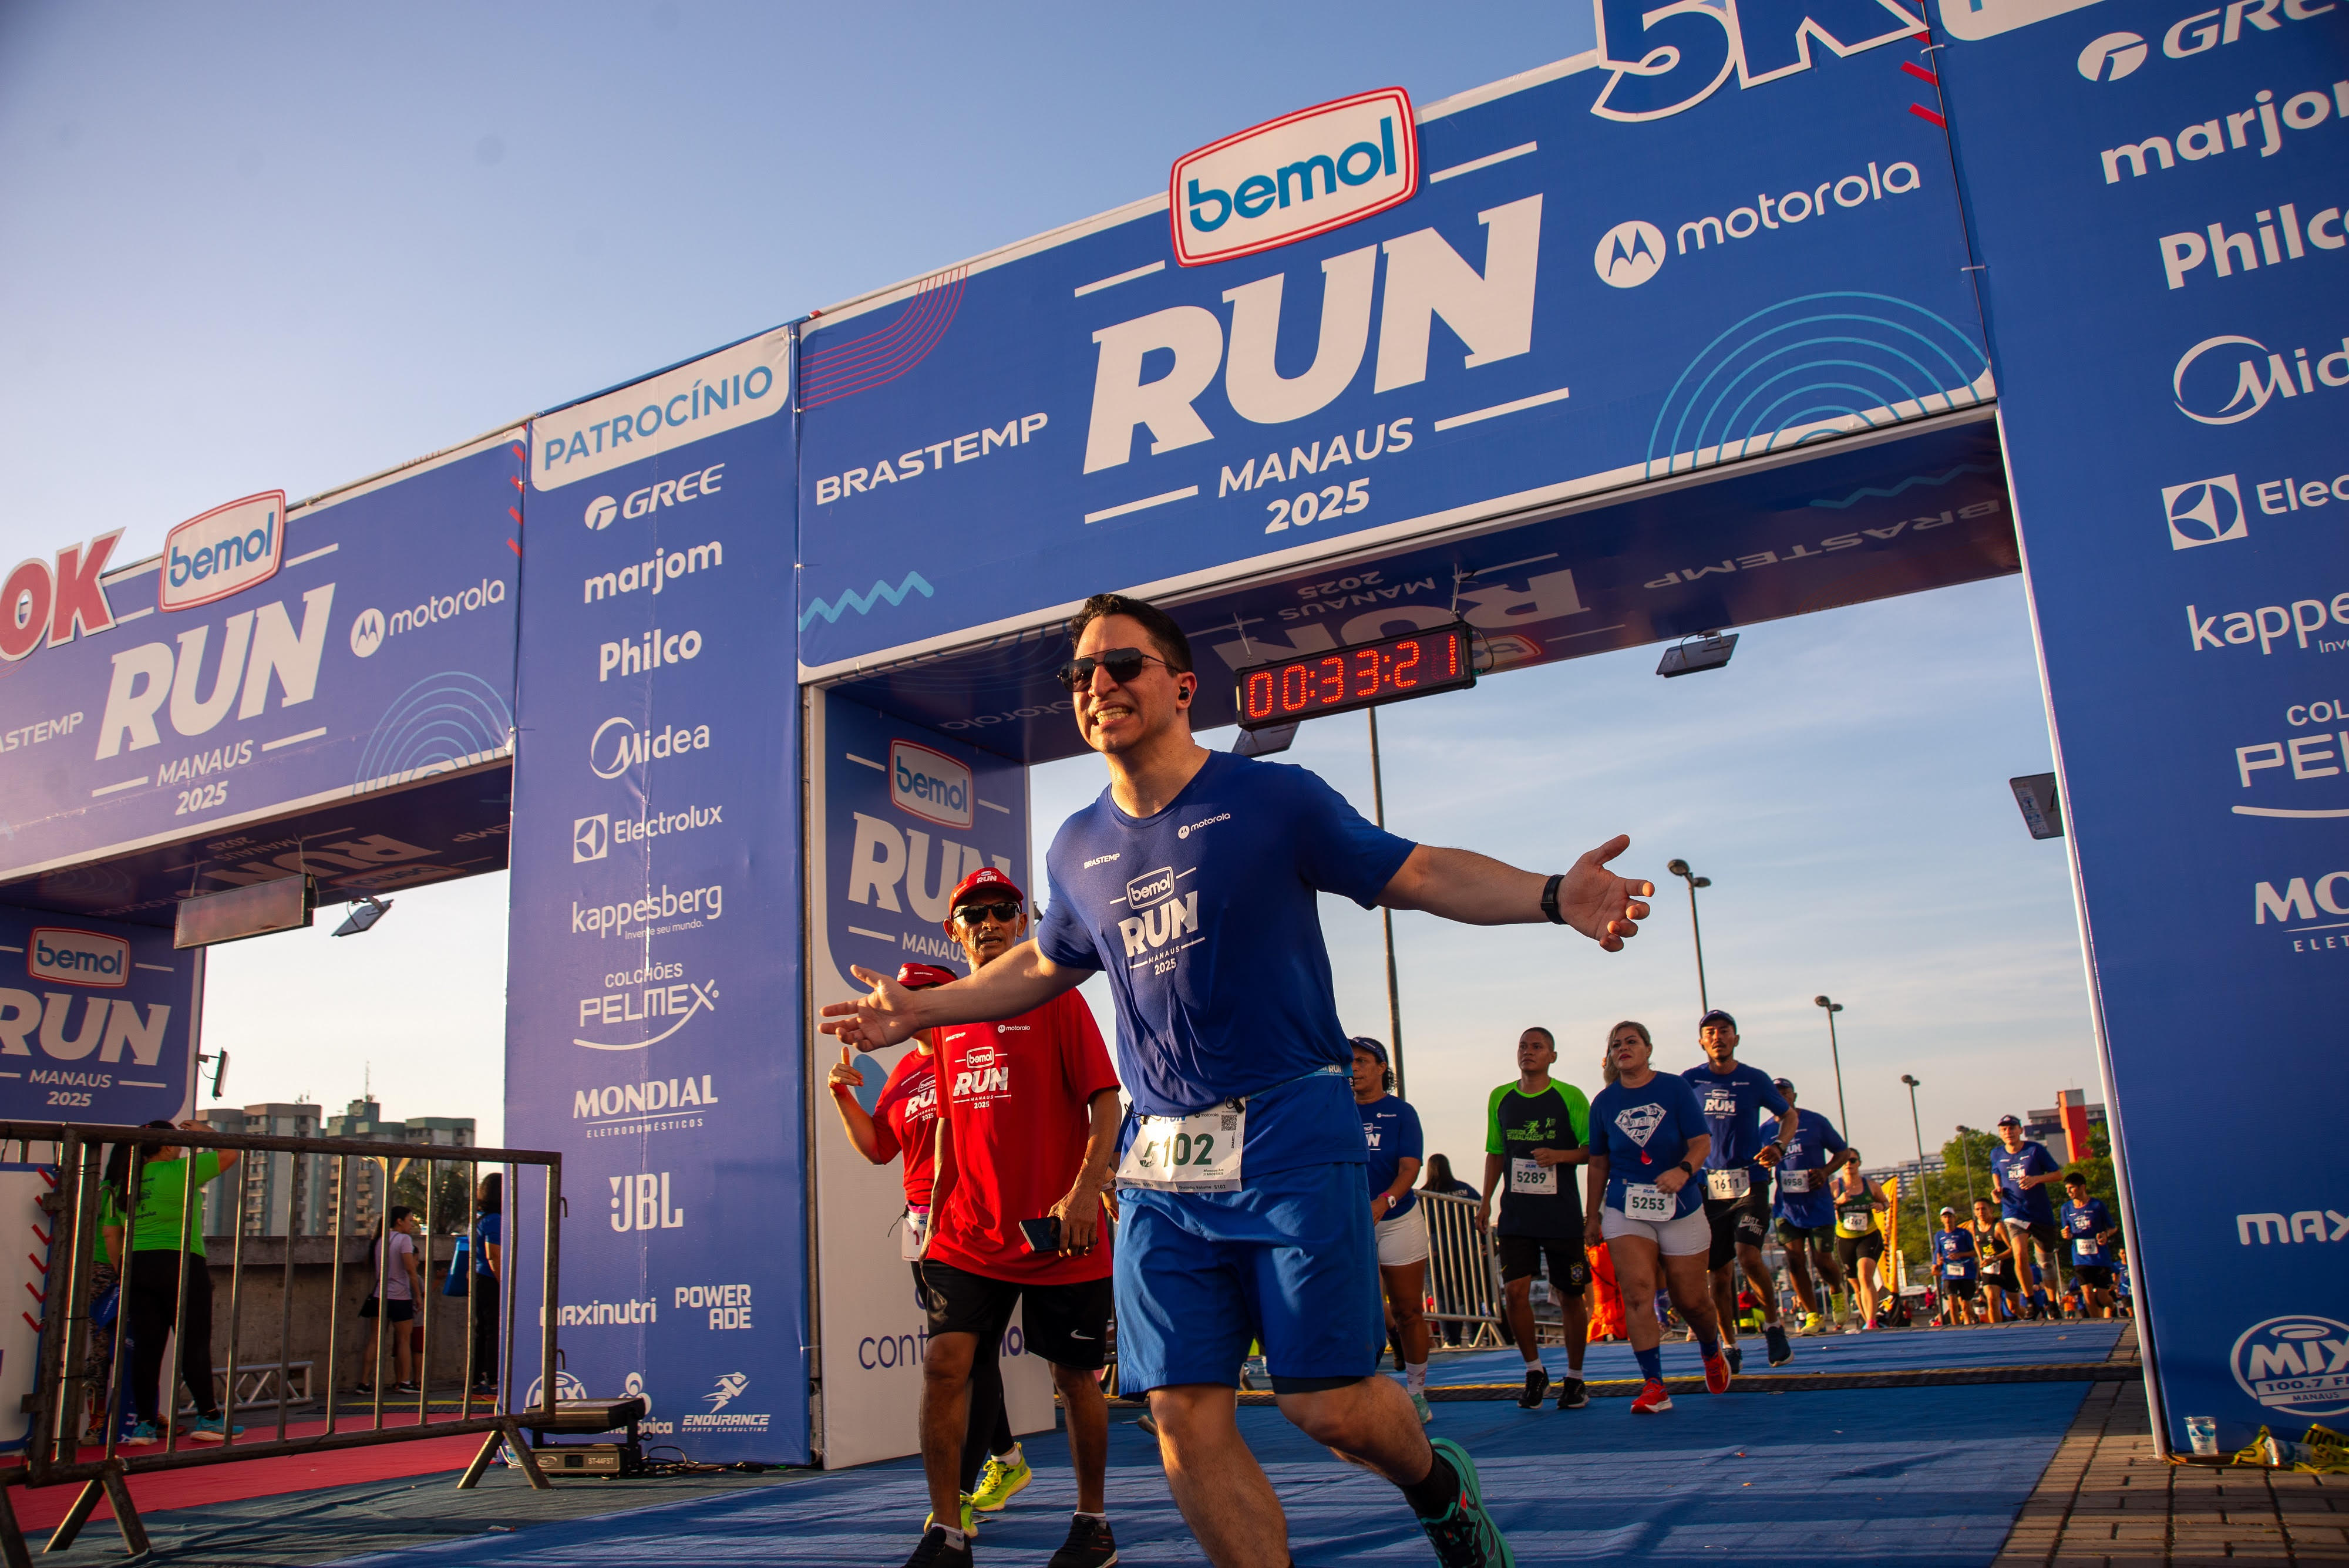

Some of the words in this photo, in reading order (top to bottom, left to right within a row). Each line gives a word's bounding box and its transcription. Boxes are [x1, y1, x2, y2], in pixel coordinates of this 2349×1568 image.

[1188, 116, 1396, 232] bemol
[1677, 161, 1920, 255] motorola
[2159, 203, 2349, 290] Philc
[1083, 193, 1543, 475] RUN
[544, 366, 772, 470] PATROCÍNIO
[817, 412, 1048, 505] BRASTEMP
[1219, 418, 1413, 497] MANAUS
[622, 463, 725, 519] GREE
[1264, 477, 1369, 534] 2025
[169, 512, 275, 588] bemol
[1644, 499, 2000, 589] BRASTEMP
[584, 541, 722, 603] marjom
[1297, 571, 1379, 600] 2025
[389, 579, 505, 636] motorola
[1278, 577, 1435, 621] MANAUS
[95, 583, 336, 761] RUN
[600, 628, 702, 682] Philco
[1249, 635, 1456, 718] 00:33:21
[938, 700, 1074, 731] otorola
[157, 740, 253, 786] MANAUS
[590, 717, 709, 779] Midea
[2236, 731, 2349, 788] PE
[175, 781, 228, 816] 2025
[896, 756, 967, 813] bemol
[614, 805, 723, 844] Electrolux
[1191, 813, 1230, 832] motorola
[206, 836, 255, 851] 2025
[214, 837, 301, 862] MANAUS
[1084, 853, 1120, 869] BRASTEMP
[977, 875, 997, 883] RUN
[1130, 873, 1170, 901] bemol
[572, 884, 722, 938] kappesberg
[1118, 890, 1198, 957] RUN
[625, 928, 655, 940] Invene
[656, 926, 671, 934] seu
[902, 932, 968, 963] MANAUS
[36, 940, 122, 975] bemol
[1148, 946, 1180, 964] MANAUS
[1155, 958, 1177, 975] 2025
[605, 963, 683, 988] COLCHÕES
[580, 979, 715, 1027] PELMEX
[0, 988, 171, 1066] RUN
[969, 1051, 992, 1064] bemol
[1328, 1065, 1342, 1074] RUN
[29, 1069, 112, 1088] MANAUS
[953, 1067, 1008, 1096] RUN
[46, 1091, 92, 1107] 2025
[573, 1075, 718, 1119] MONDIAL
[1704, 1099, 1736, 1113] RUN
[587, 1118, 704, 1138] ELETRODOMÉSTICOS
[1786, 1144, 1802, 1155] UN
[1517, 1172, 1546, 1184] 5289
[1715, 1178, 1739, 1190] 1611
[611, 1172, 684, 1232] JBL
[1632, 1196, 1665, 1210] 5253
[540, 1297, 657, 1326] axinutri
[675, 1284, 751, 1308] POWER
[709, 1306, 752, 1330] ADE
[859, 1325, 928, 1370] cont
[2266, 1378, 2324, 1392] 100.7
[2293, 1391, 2340, 1402] MANAUS
[682, 1414, 770, 1425] ENDURANCE
